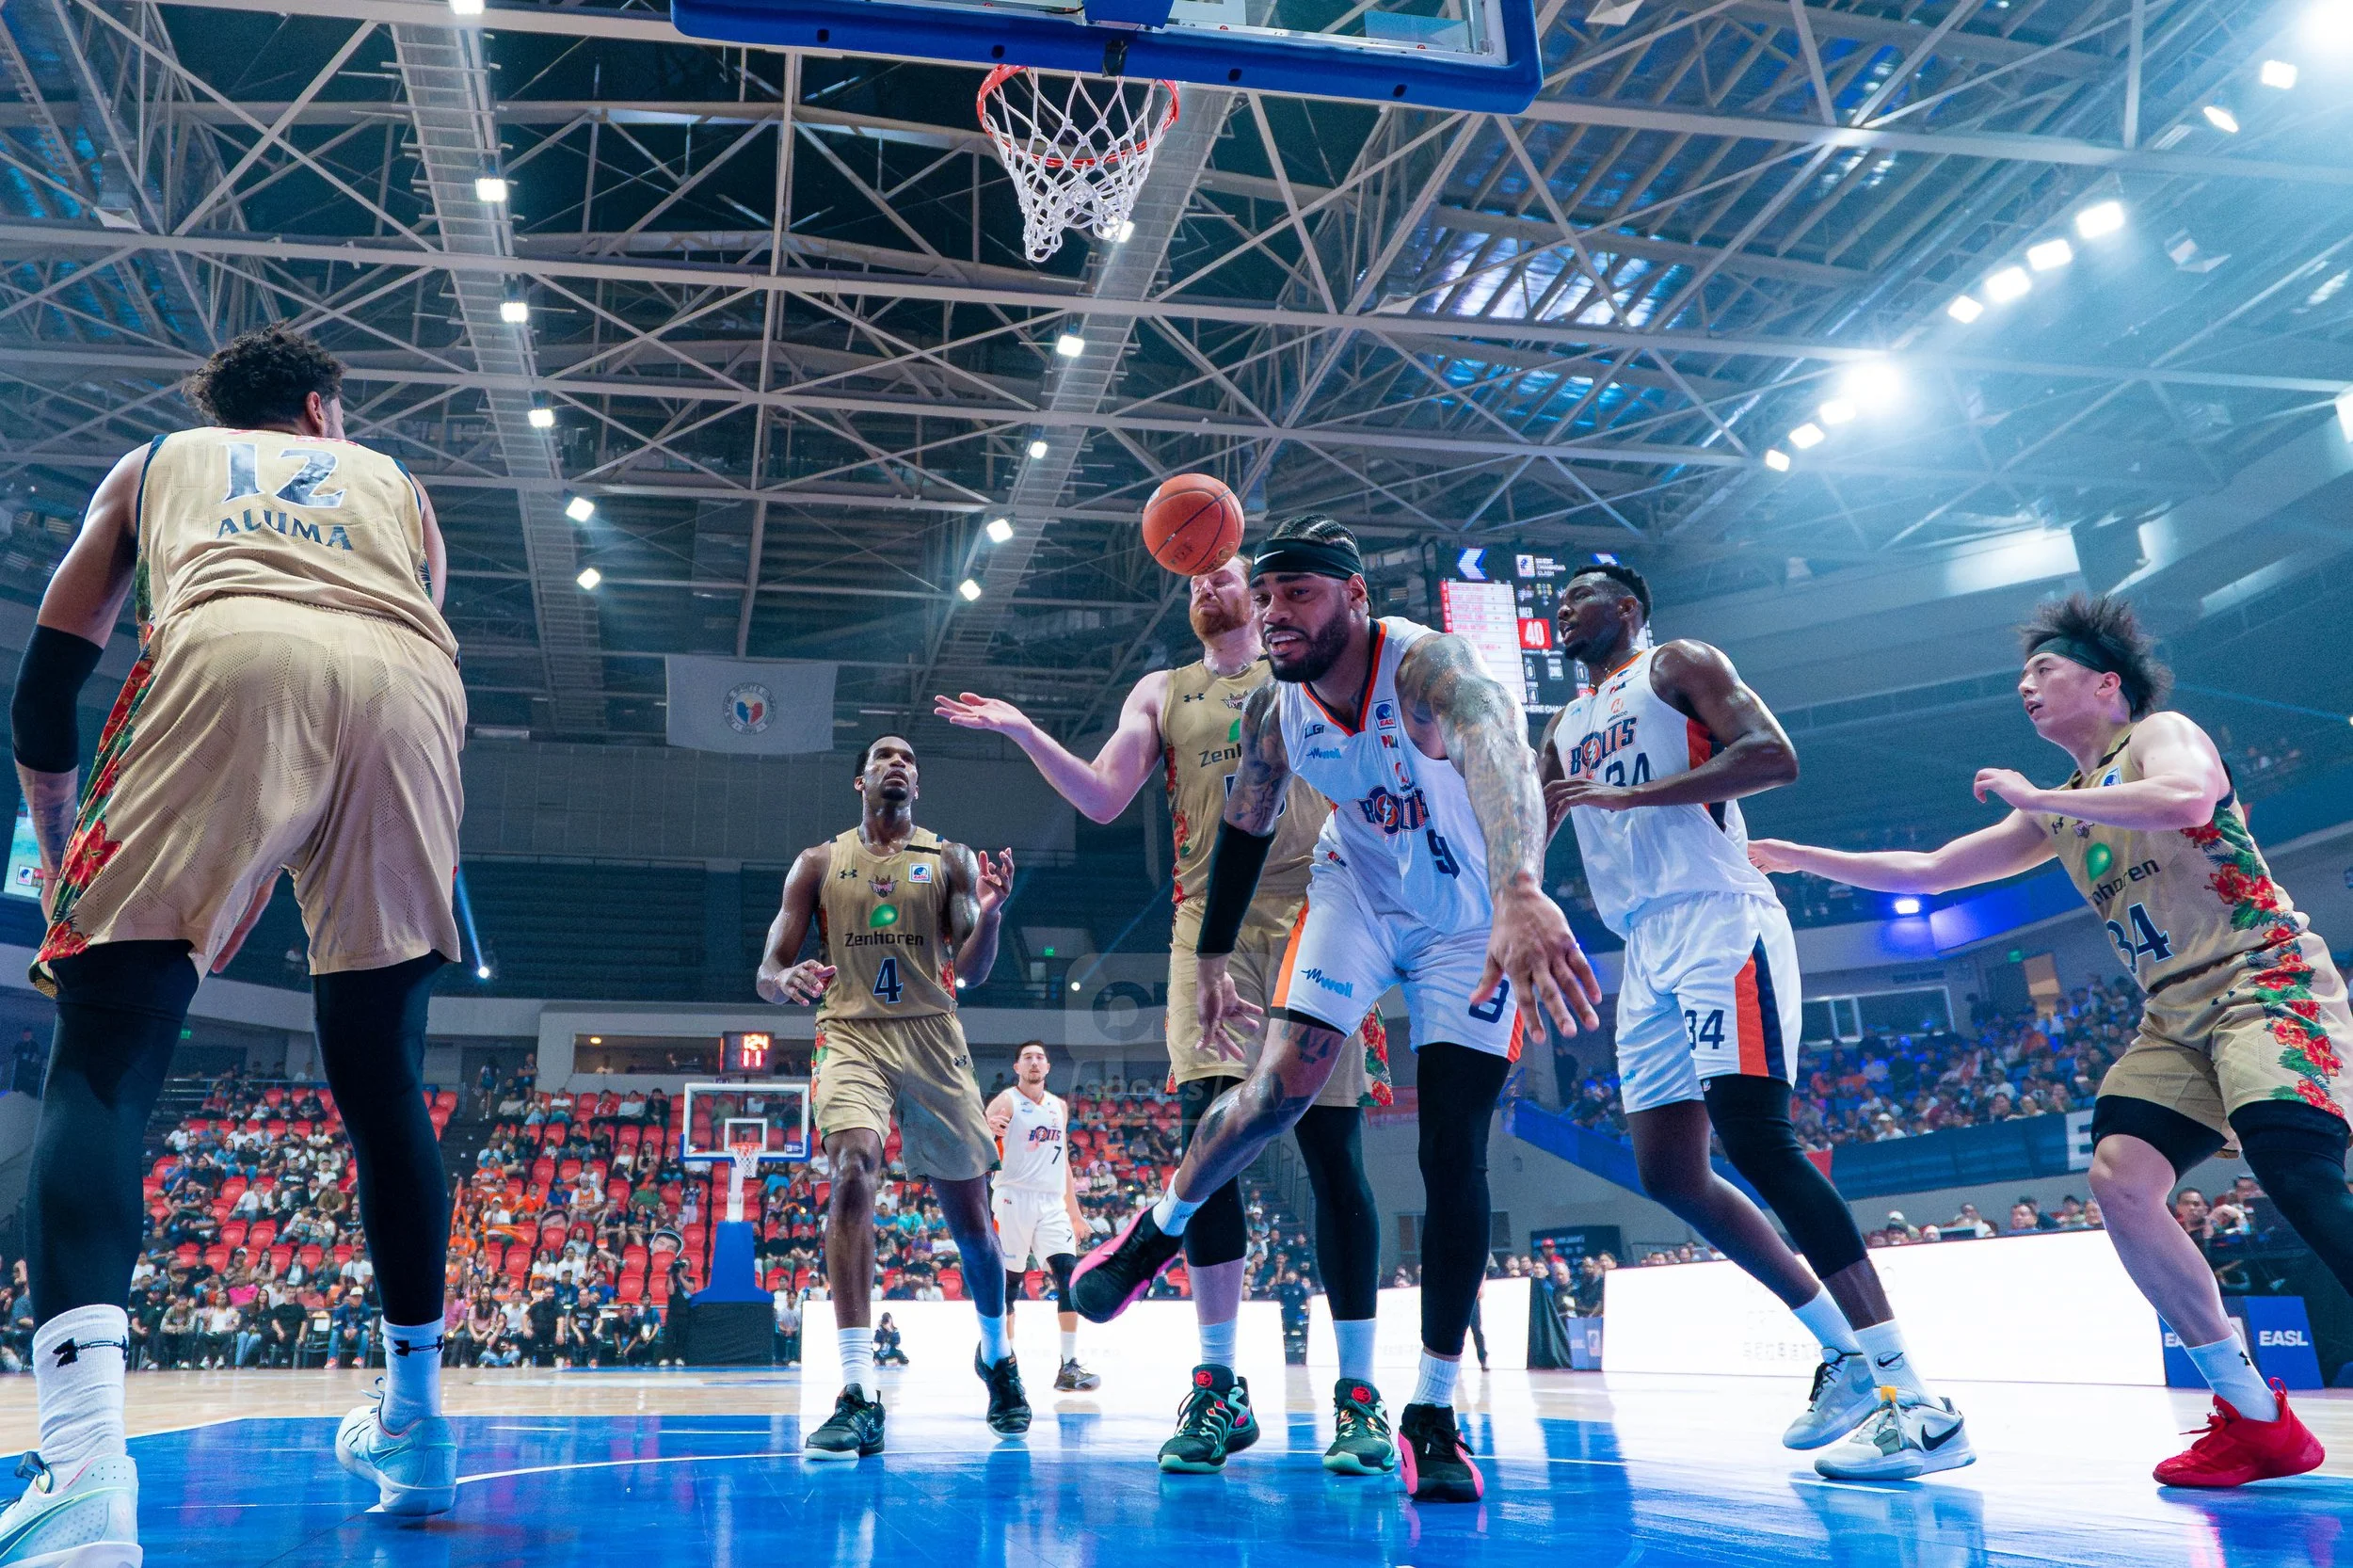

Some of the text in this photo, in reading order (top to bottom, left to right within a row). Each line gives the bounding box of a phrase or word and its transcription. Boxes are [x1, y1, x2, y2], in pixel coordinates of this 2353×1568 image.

[219, 441, 347, 508] 12
[216, 508, 354, 551] ALUMA
[1525, 621, 1545, 646] 40
[1570, 716, 1639, 778] BOLTS
[1426, 828, 1461, 880] 9
[845, 931, 924, 948] Zenhoren
[873, 956, 904, 1005] 4
[1029, 1126, 1062, 1142] BOLTS
[1051, 1144, 1062, 1165] 7
[2259, 1330, 2309, 1347] EASL
